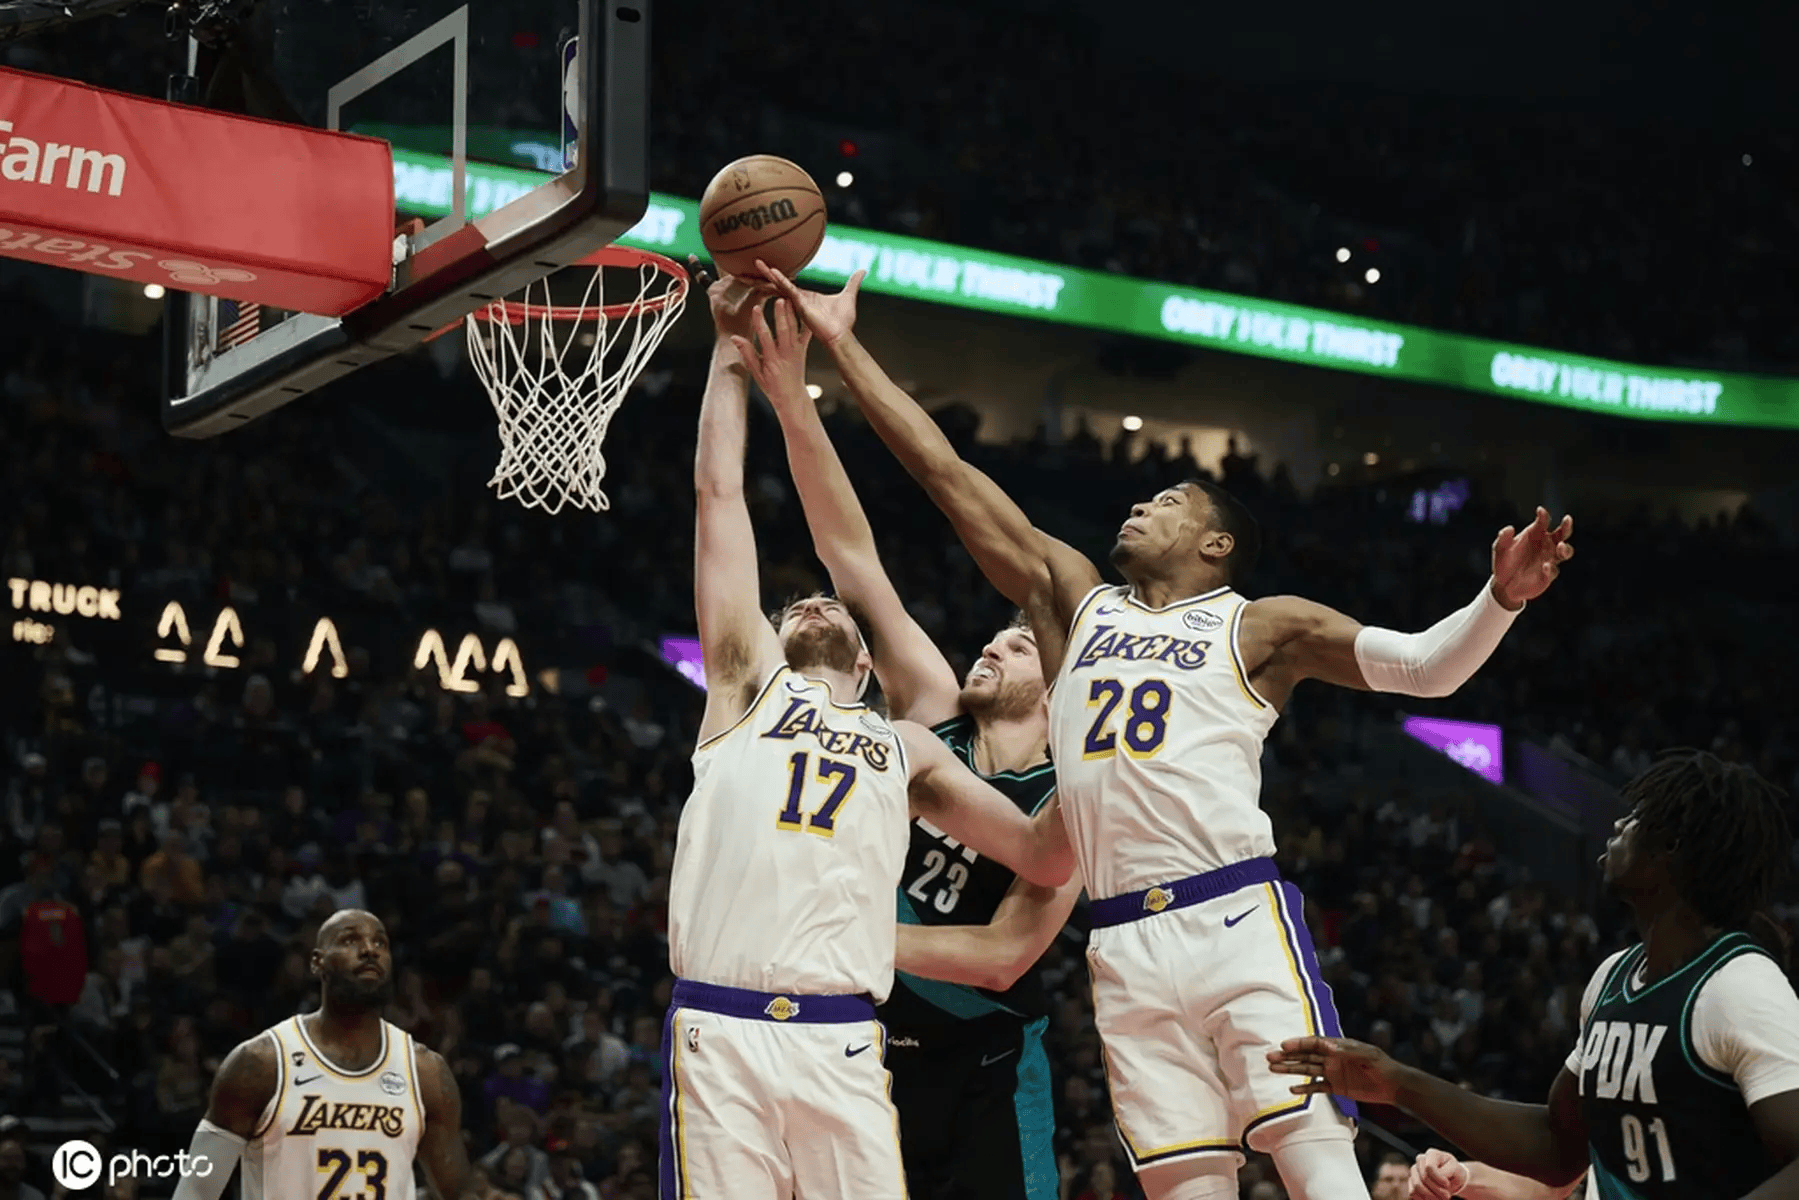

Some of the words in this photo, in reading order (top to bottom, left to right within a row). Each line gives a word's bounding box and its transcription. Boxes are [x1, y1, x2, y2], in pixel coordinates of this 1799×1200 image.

[713, 198, 798, 236] Wilson
[8, 577, 121, 620] TRUCK
[1070, 624, 1213, 672] LAKERS
[759, 696, 891, 773] LAKERS
[1082, 678, 1172, 761] 28
[776, 751, 857, 838] 17
[907, 849, 969, 914] 23
[1578, 1021, 1668, 1104] PDX
[286, 1095, 405, 1138] LAKERS
[1621, 1114, 1676, 1183] 91
[317, 1147, 388, 1200] 23
